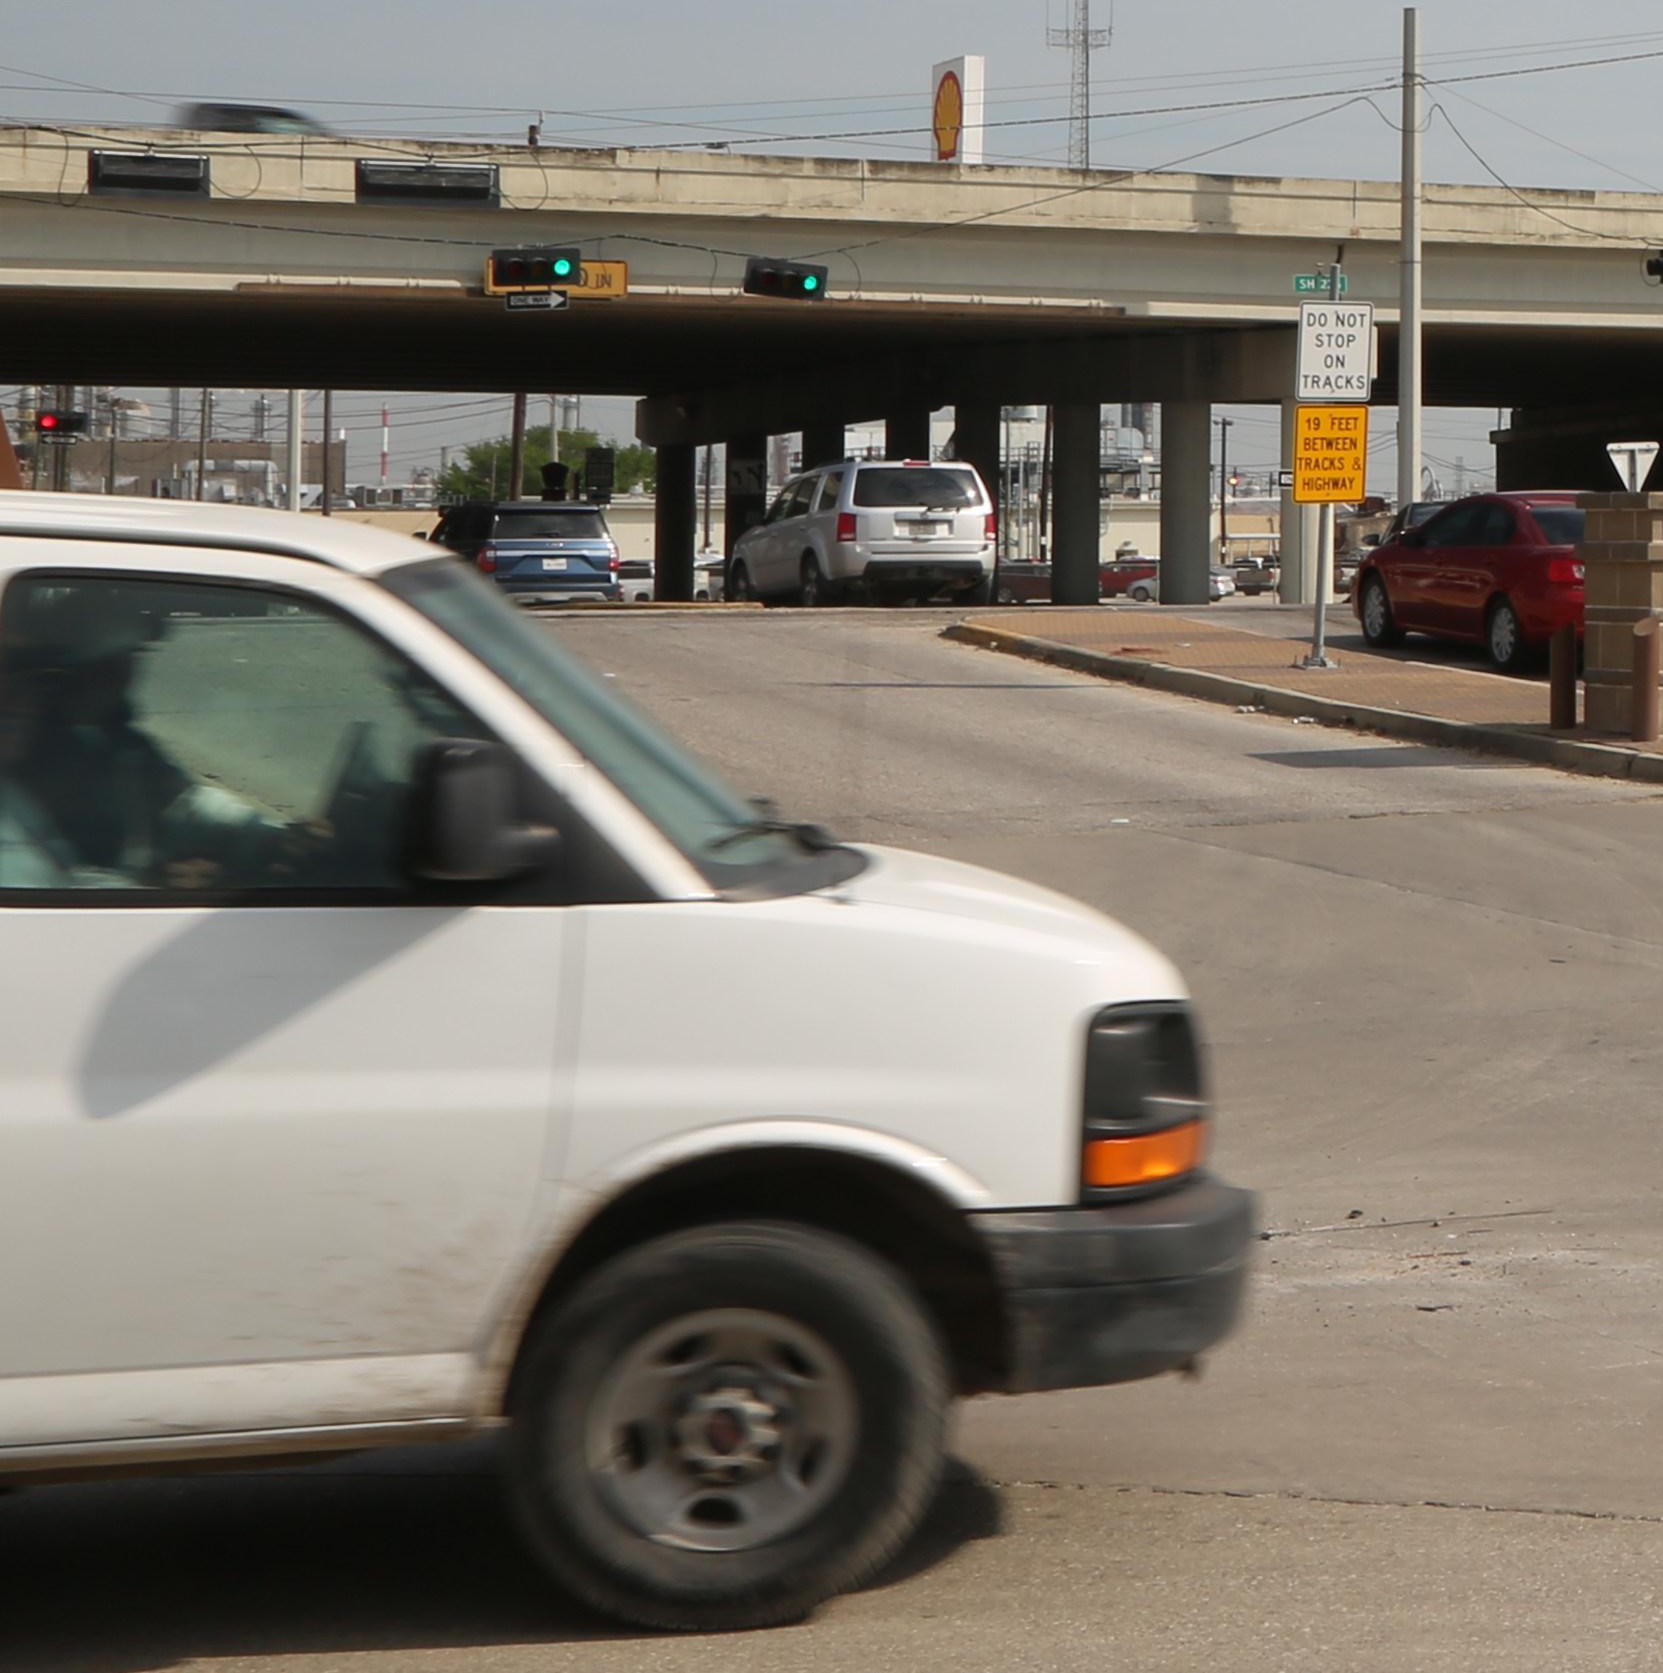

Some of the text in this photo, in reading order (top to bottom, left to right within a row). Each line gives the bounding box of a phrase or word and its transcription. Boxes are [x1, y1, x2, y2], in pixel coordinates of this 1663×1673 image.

[595, 273, 612, 288] IN
[1299, 278, 1316, 289] SH
[1307, 313, 1367, 328] DO NOT
[1315, 333, 1356, 348] STOP
[1324, 354, 1345, 368] ON
[1302, 374, 1365, 389] TRACKS
[1306, 417, 1359, 431] 19 FEET
[1303, 437, 1357, 451] BETWEEN
[1296, 456, 1361, 471] TRACKS &
[1303, 477, 1355, 491] HIGHWAY
